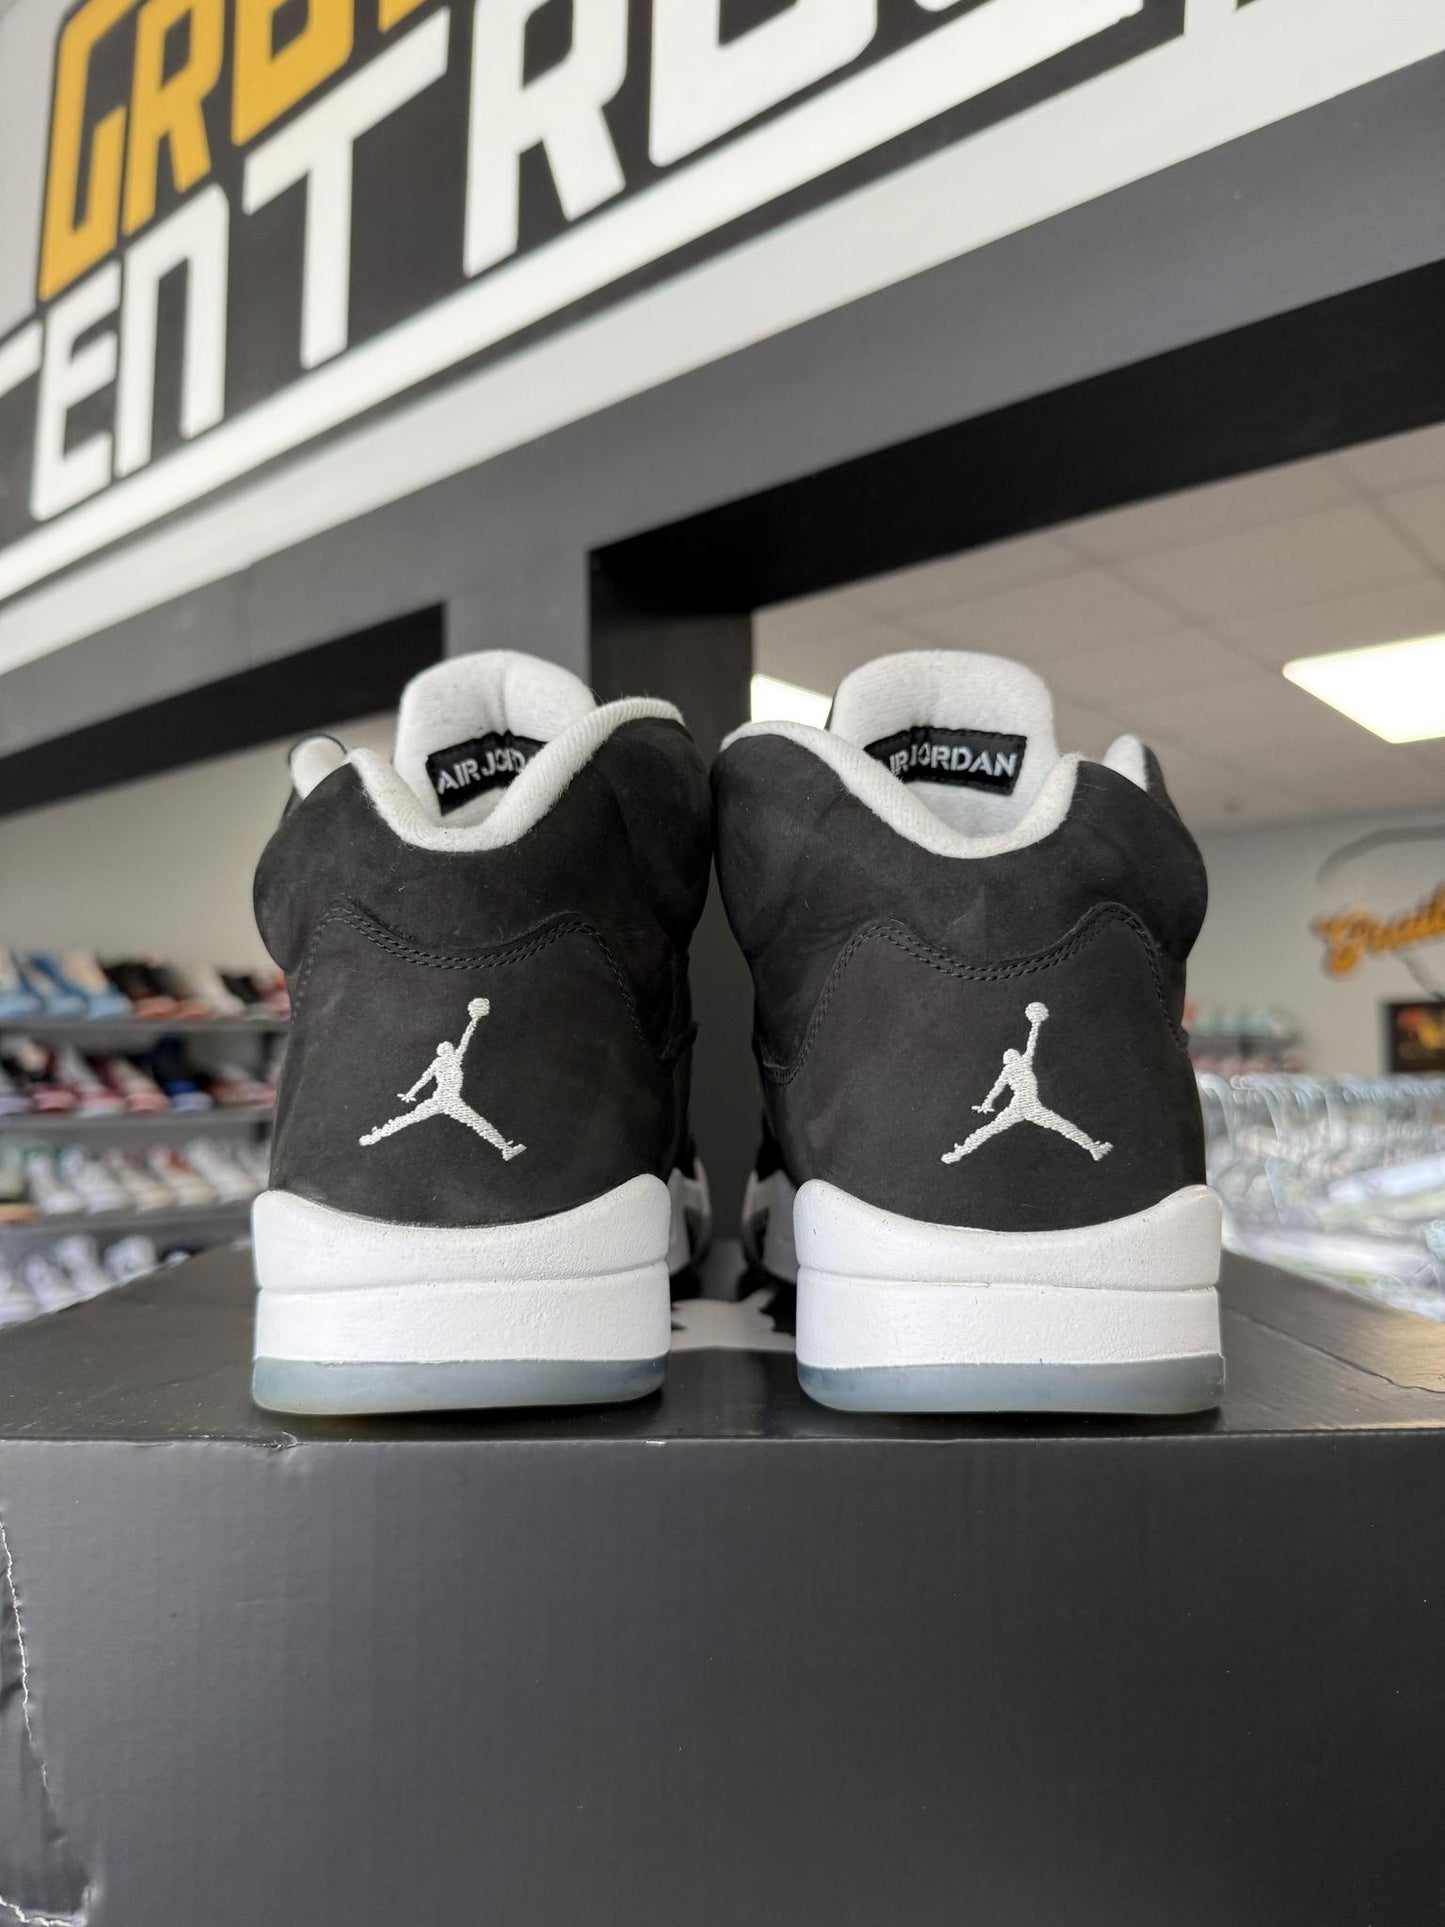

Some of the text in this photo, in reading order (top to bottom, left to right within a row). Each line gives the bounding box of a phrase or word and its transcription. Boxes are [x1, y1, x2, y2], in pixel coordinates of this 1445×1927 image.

[437, 757, 481, 795] AIR
[889, 741, 1019, 778] IR JORDAN
